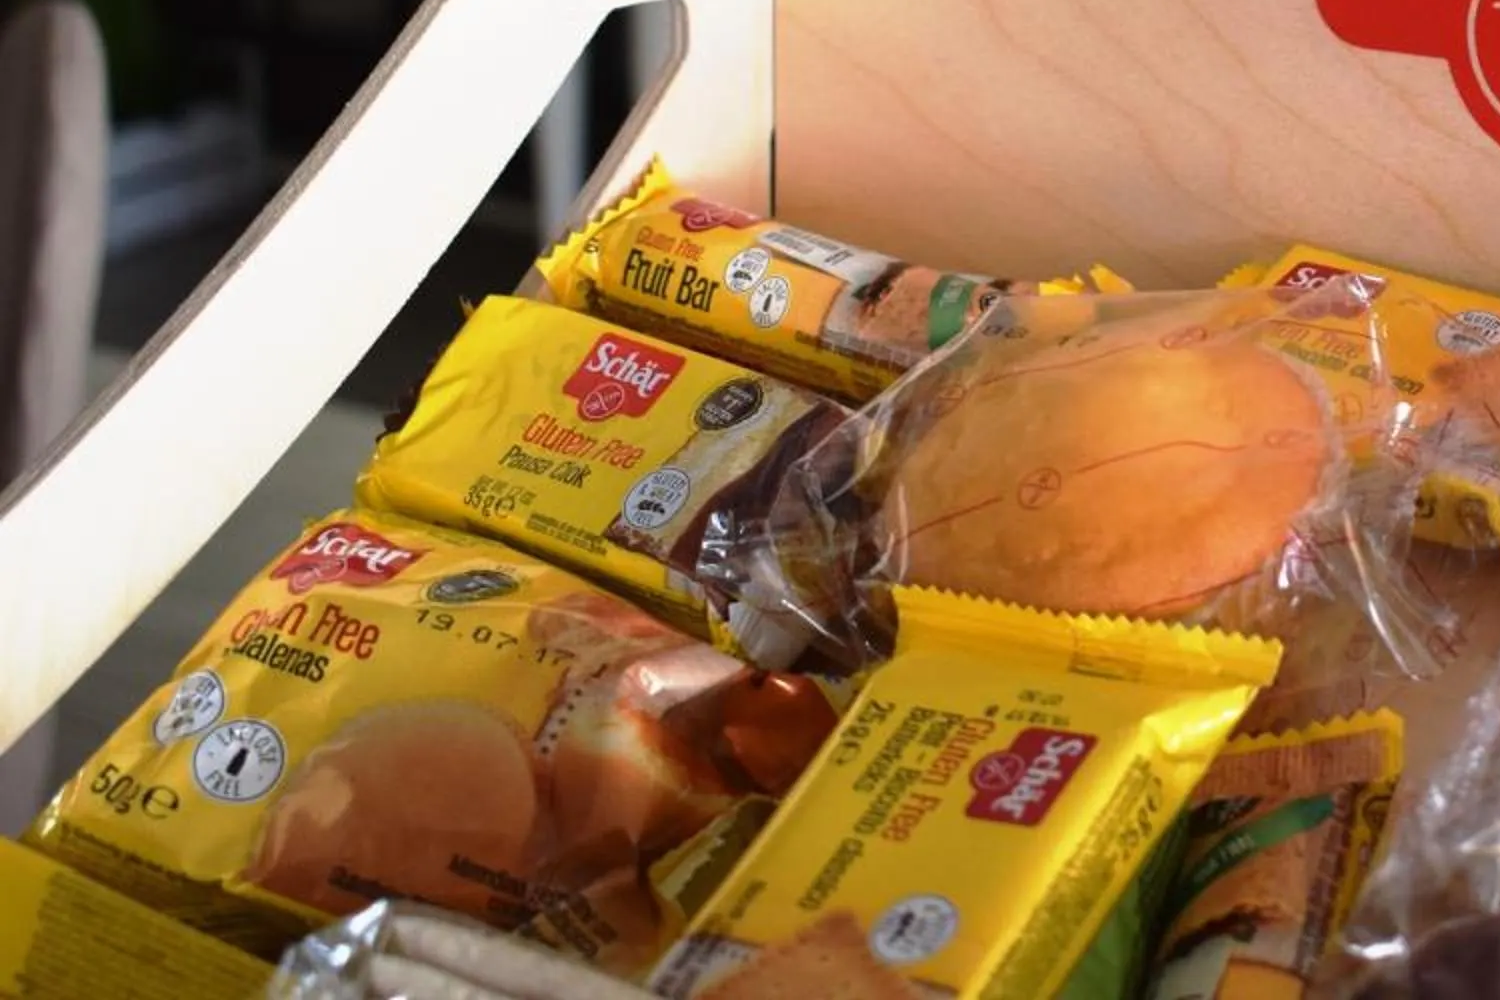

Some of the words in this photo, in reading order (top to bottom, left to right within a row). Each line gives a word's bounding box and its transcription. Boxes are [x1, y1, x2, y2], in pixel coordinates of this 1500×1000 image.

[621, 248, 674, 300] Fruit
[675, 264, 720, 313] Bar
[585, 341, 671, 397] Schär
[523, 413, 597, 459] Gluten
[595, 439, 645, 469] Free
[309, 602, 380, 660] Free
[216, 726, 277, 762] LACTOSE
[921, 717, 996, 787] Gluten
[204, 769, 240, 797] FREE
[881, 792, 943, 842] Free
